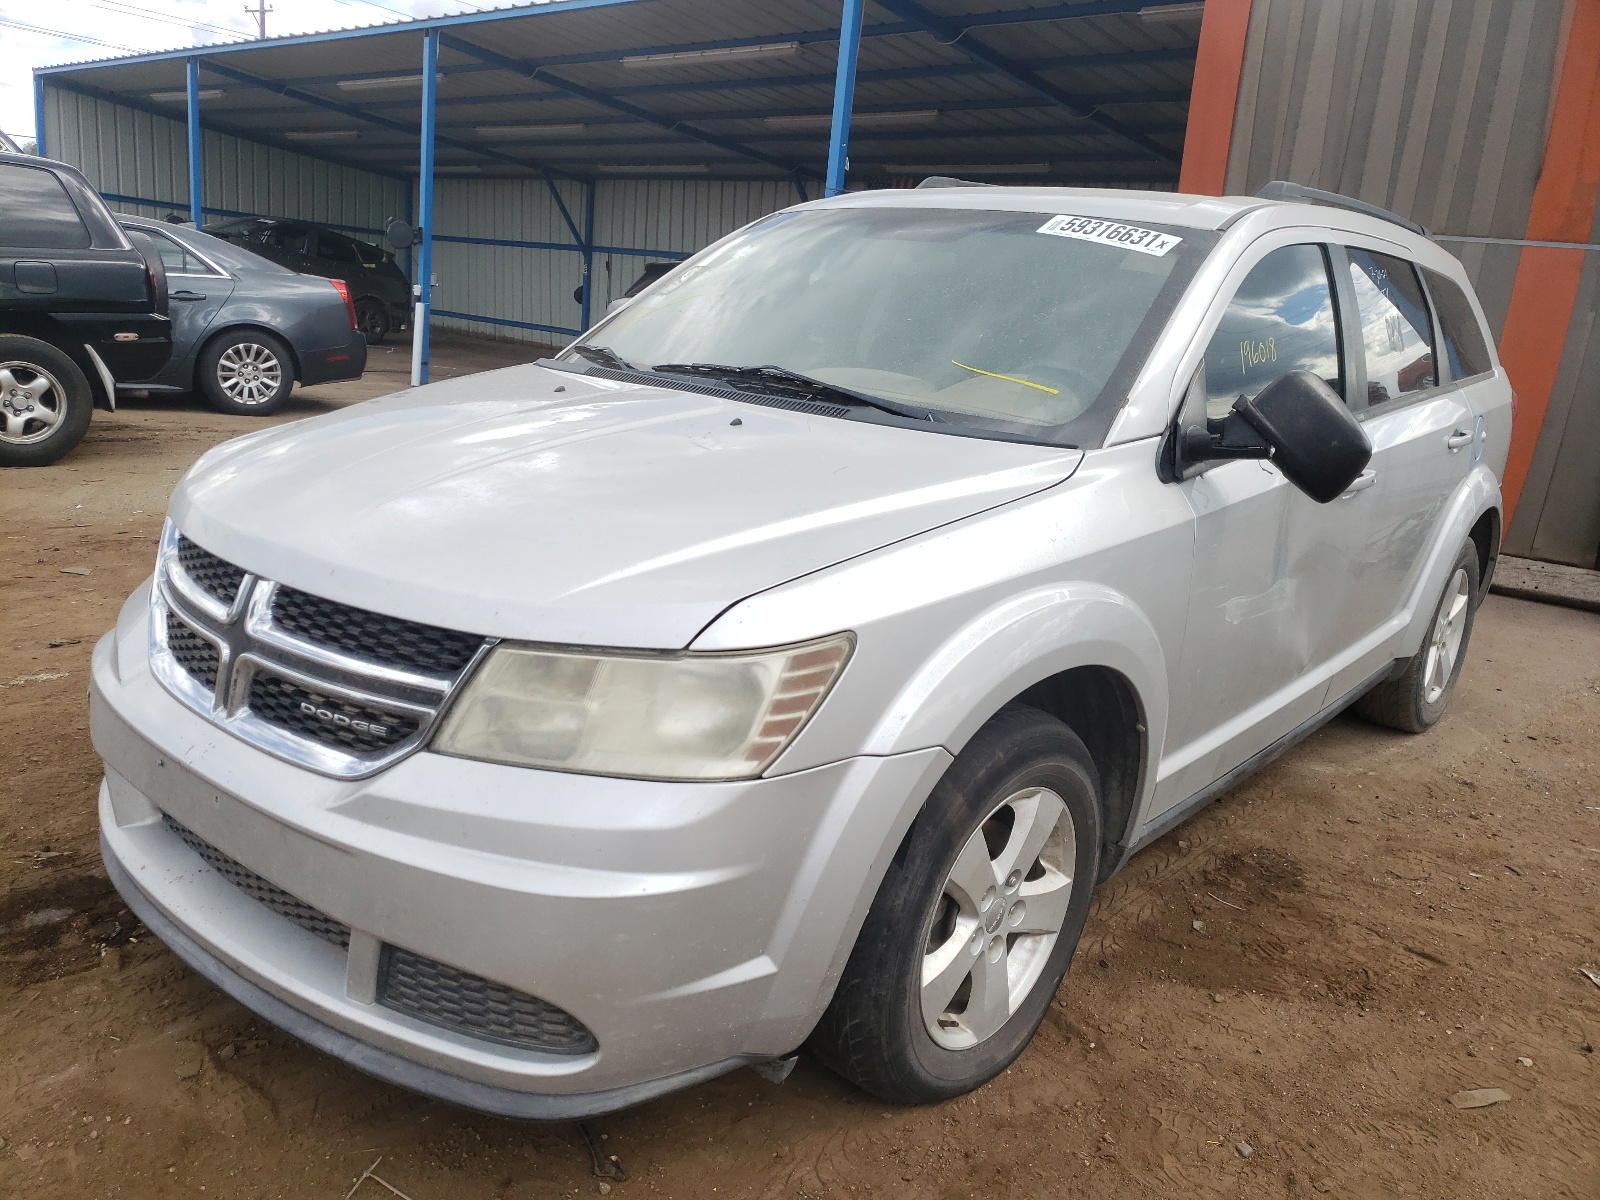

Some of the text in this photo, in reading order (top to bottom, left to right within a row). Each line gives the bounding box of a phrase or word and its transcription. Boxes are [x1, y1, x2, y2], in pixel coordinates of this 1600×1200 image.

[1060, 217, 1162, 248] 59316631
[1240, 337, 1277, 375] 196018
[300, 702, 387, 736] DODGE
